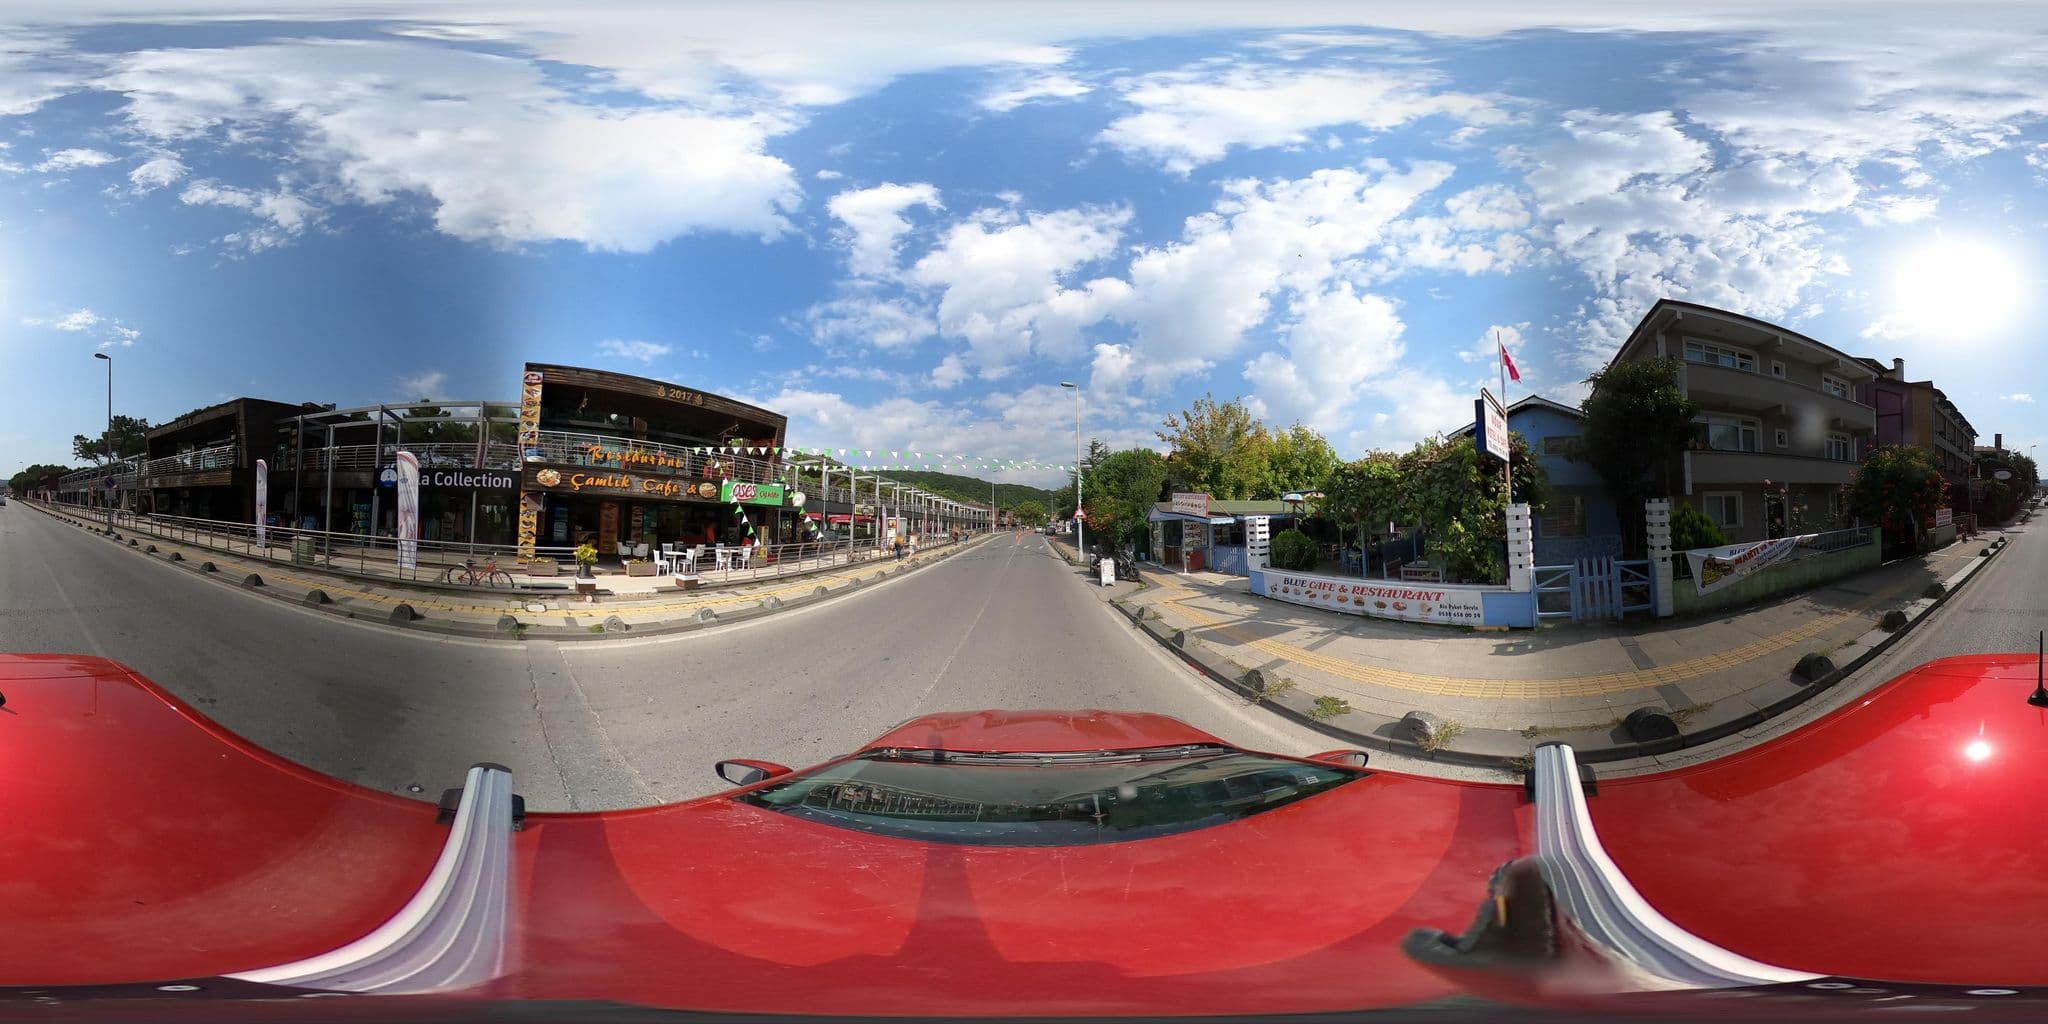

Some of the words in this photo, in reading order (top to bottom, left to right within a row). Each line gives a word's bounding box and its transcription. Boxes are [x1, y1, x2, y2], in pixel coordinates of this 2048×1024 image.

[670, 388, 692, 401] 2017
[588, 444, 681, 468] Restaurant
[434, 472, 512, 489] Collection
[643, 479, 679, 497] Cafe
[687, 484, 697, 494] &
[1283, 577, 1307, 588] BLUE
[1309, 581, 1336, 592] CAFE
[1338, 584, 1349, 594] &
[1351, 585, 1445, 602] RESTAURANT
